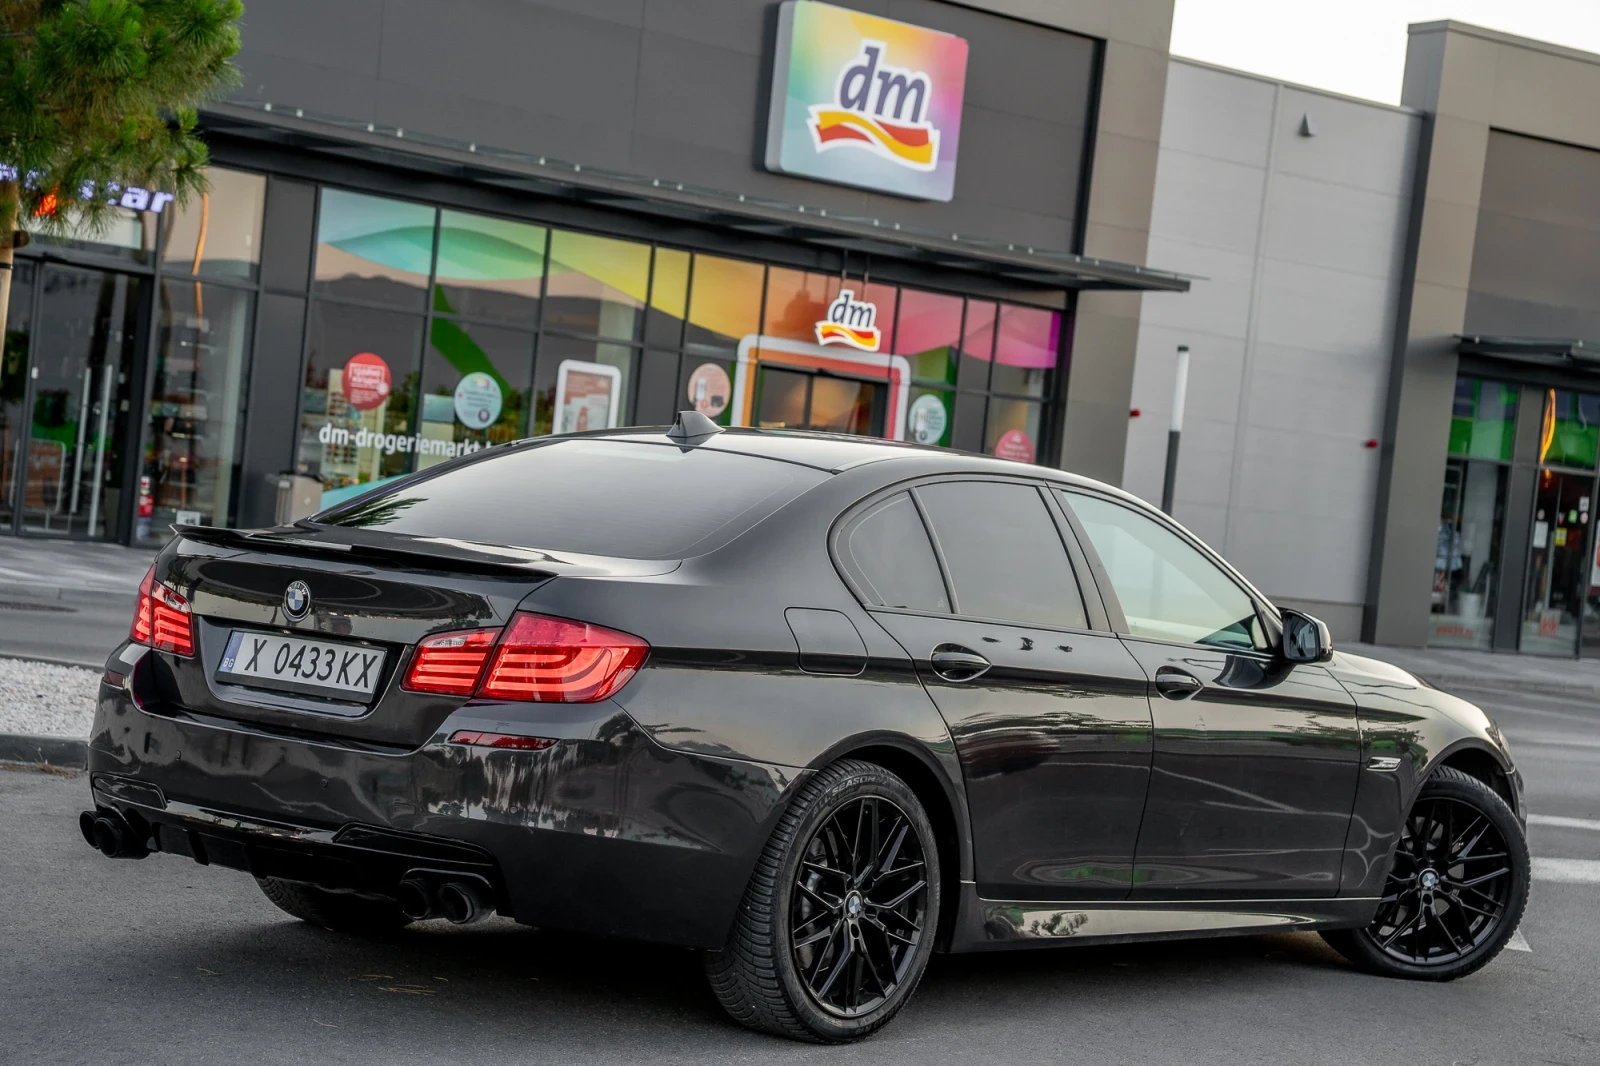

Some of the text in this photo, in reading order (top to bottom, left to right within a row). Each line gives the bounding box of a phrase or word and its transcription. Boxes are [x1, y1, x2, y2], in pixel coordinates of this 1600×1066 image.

[840, 46, 925, 124] dm
[832, 294, 872, 328] dm
[223, 657, 235, 668] BG
[244, 638, 268, 672] X
